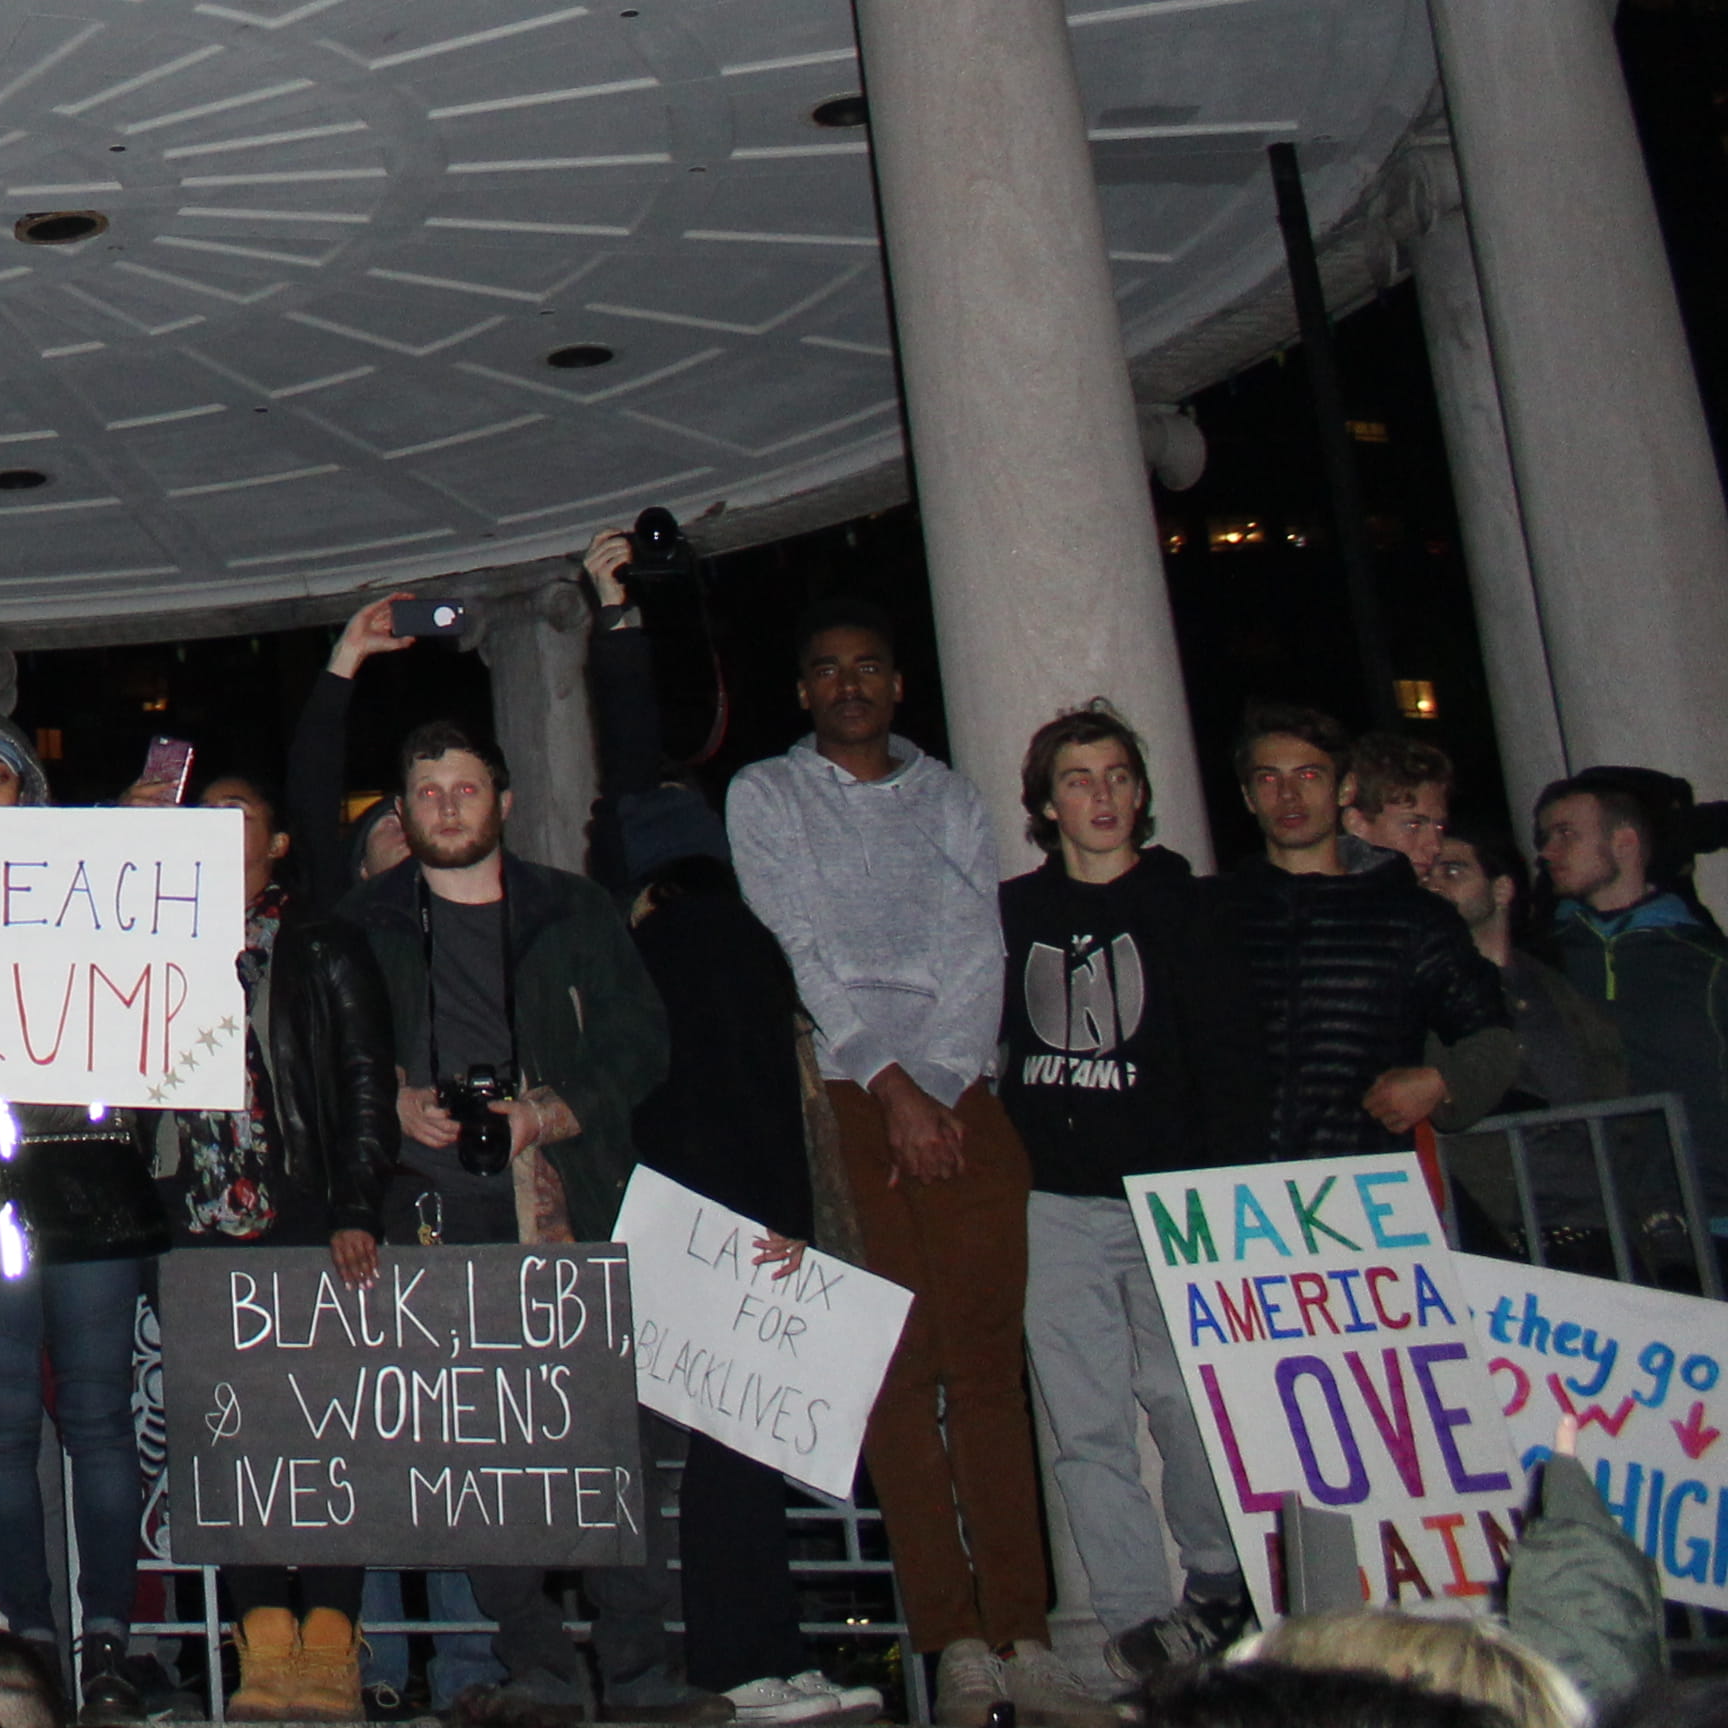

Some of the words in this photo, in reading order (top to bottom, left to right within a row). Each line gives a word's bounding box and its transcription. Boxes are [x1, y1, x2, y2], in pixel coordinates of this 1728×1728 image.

[1144, 1170, 1432, 1267] MAKE
[732, 1293, 808, 1358] FOR
[1185, 1262, 1457, 1347] AMERICA
[1486, 1292, 1619, 1397] they
[1632, 1341, 1721, 1409] go
[287, 1364, 572, 1445] WOMEN'S
[1197, 1341, 1513, 1514] LOVE
[192, 1455, 356, 1529] LIVES
[409, 1465, 640, 1535] MATTER
[1265, 1507, 1526, 1615] AIN
